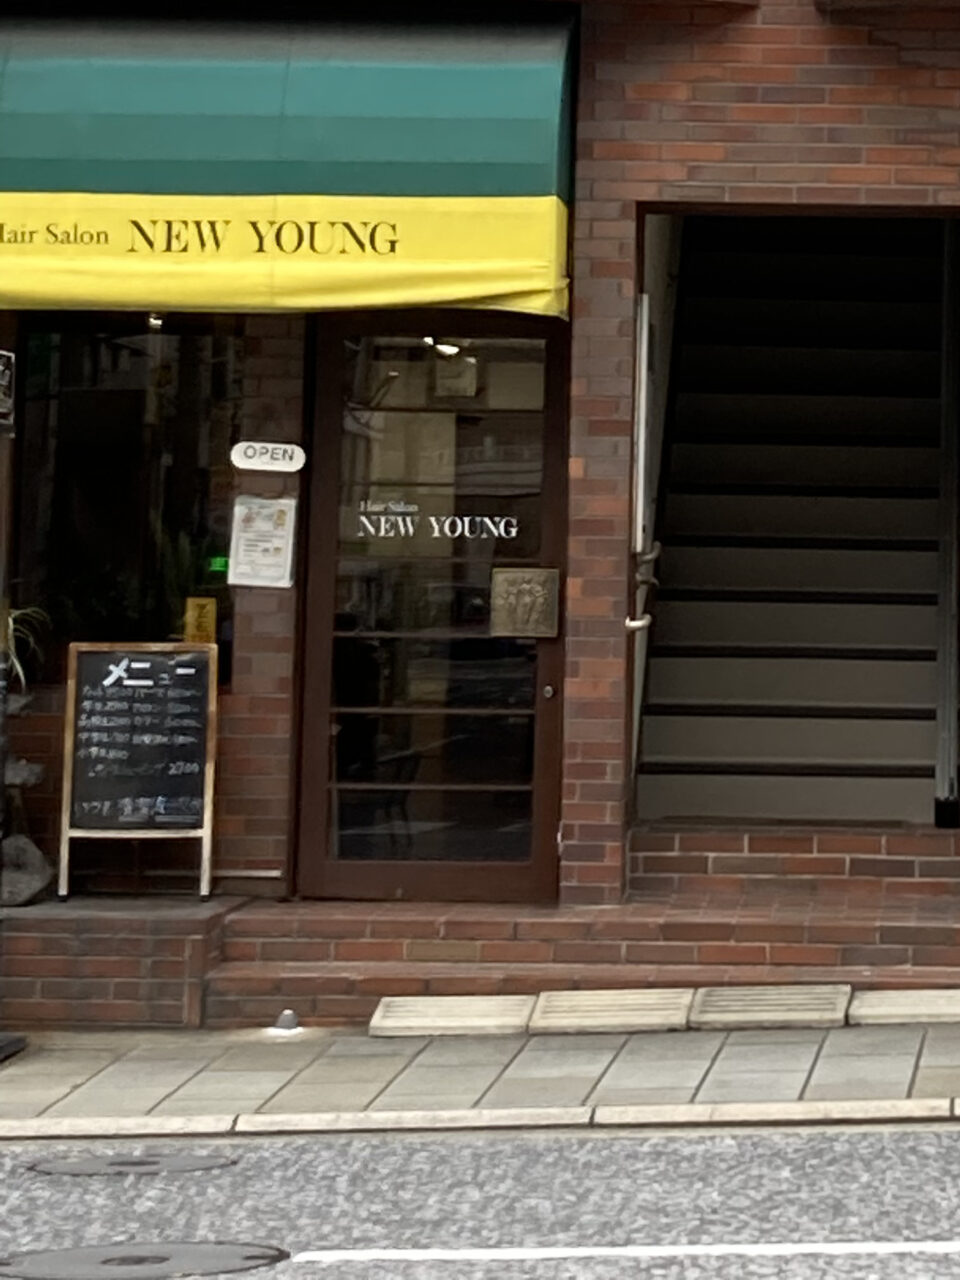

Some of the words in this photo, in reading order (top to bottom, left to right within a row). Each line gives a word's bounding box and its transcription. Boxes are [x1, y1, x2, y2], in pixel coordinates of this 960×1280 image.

[0, 223, 38, 244] air
[45, 223, 109, 245] Salon
[127, 219, 231, 253] NEW
[249, 220, 399, 255] YOUNG
[243, 445, 295, 462] OPEN
[358, 515, 419, 537] NEW
[428, 516, 519, 539] YOUNG
